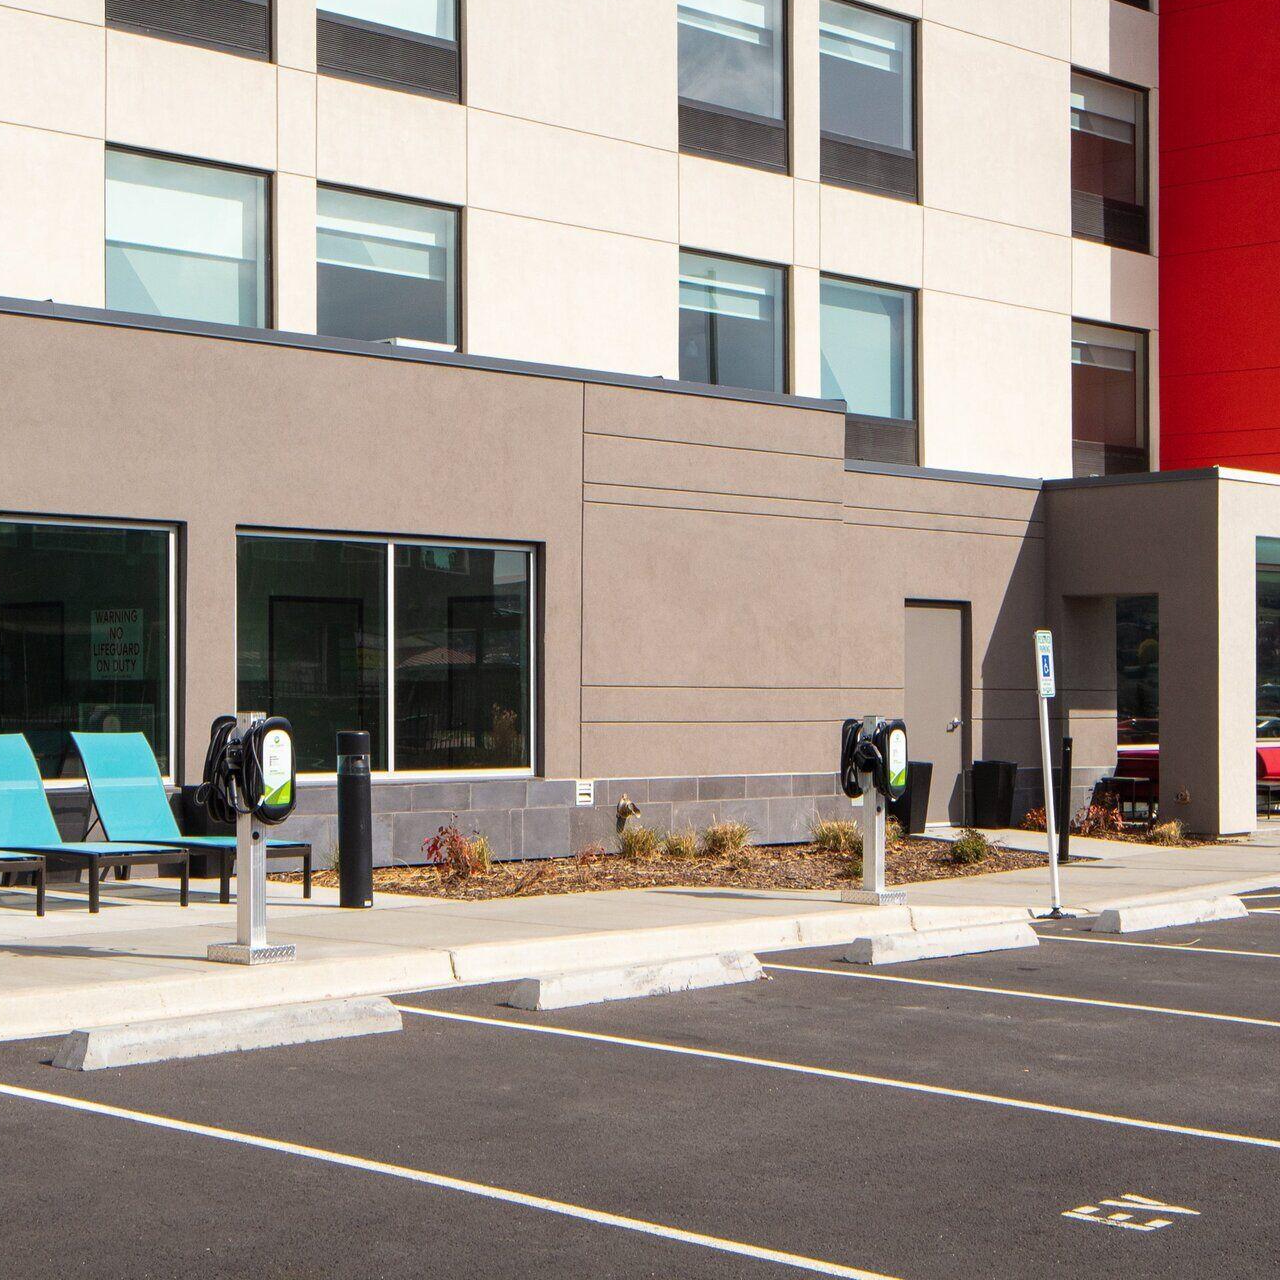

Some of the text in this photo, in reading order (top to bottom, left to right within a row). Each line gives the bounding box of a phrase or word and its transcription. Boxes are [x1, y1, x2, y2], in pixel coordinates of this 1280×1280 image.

[95, 610, 138, 624] WARNING
[109, 626, 124, 640] NO
[93, 642, 141, 656] LIFEGUARD
[96, 659, 137, 673] ON DUTY
[1060, 1192, 1202, 1232] EV
